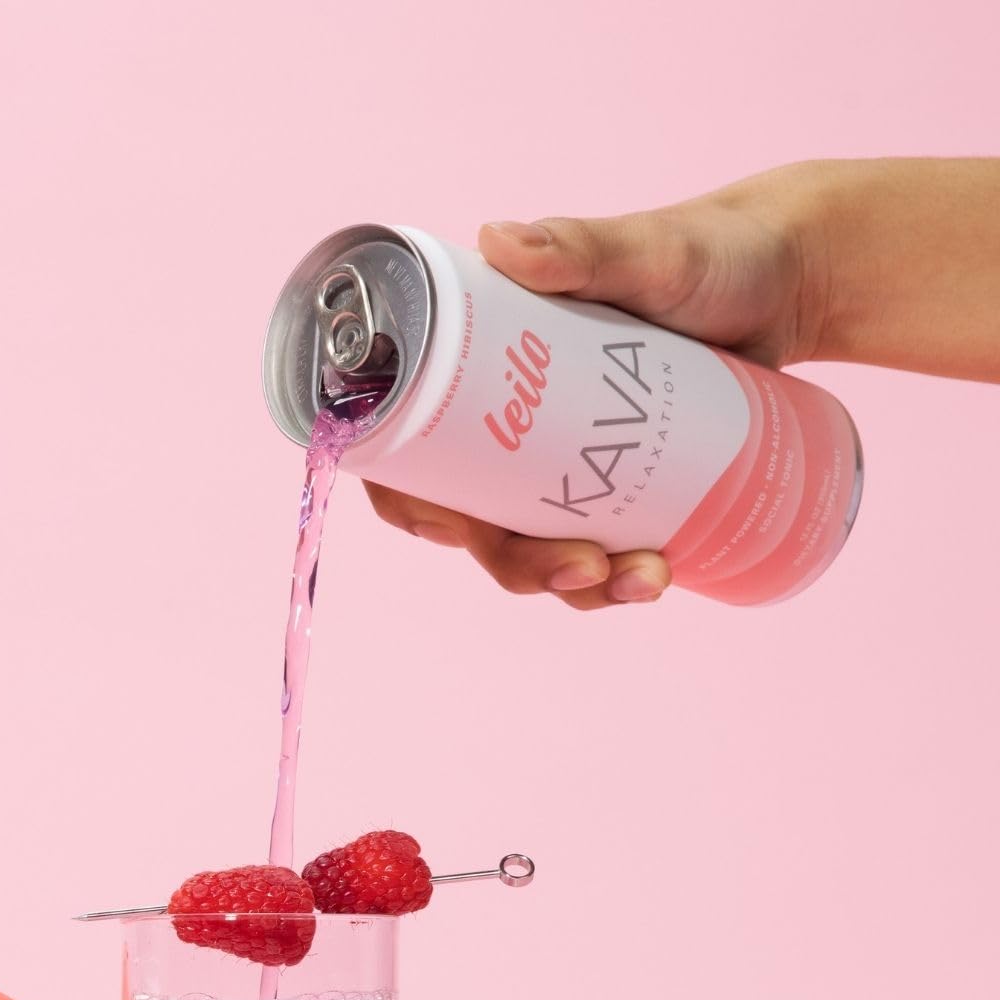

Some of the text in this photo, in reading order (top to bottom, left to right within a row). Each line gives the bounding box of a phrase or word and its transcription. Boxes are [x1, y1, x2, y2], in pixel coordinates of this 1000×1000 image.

[422, 291, 473, 438] RASPBERRY HIBISCUS
[483, 328, 552, 453] leilo
[539, 341, 652, 518] KAVA
[612, 362, 674, 516] RELAXATION
[759, 449, 795, 534] SOCIAL TONIC
[699, 544, 731, 570] PLANT
[731, 491, 767, 544] POWERED
